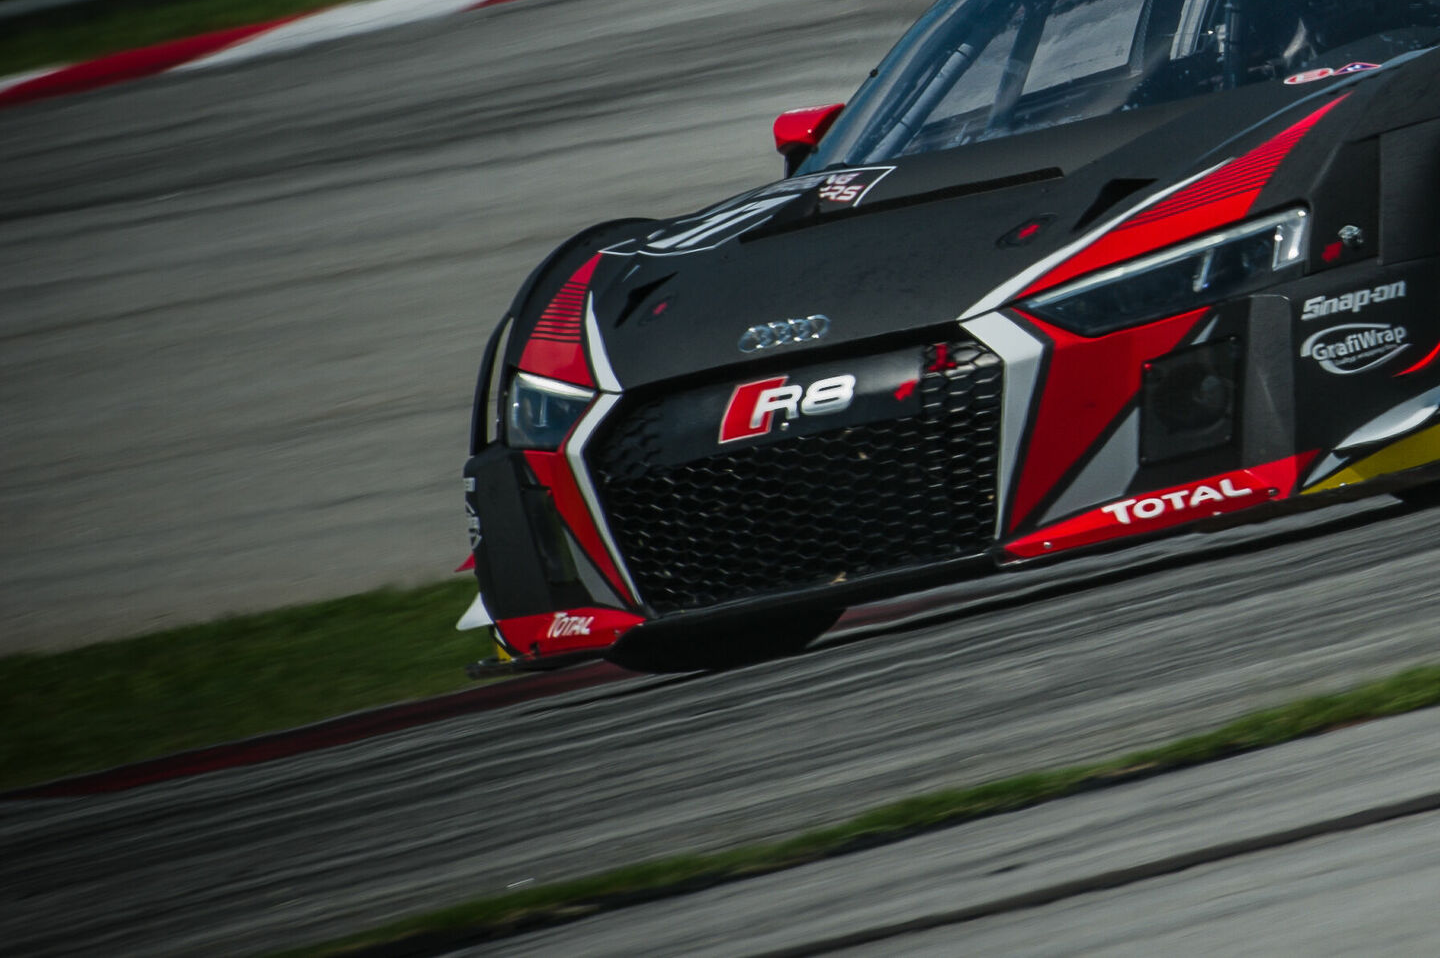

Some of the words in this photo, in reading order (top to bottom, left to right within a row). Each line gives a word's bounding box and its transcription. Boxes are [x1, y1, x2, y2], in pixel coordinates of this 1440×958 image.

[1301, 280, 1407, 321] Snap-on
[1312, 326, 1407, 361] GrafiWrap
[742, 374, 856, 432] R8
[1101, 478, 1253, 525] TOTAL
[546, 612, 595, 639] TOTAL
